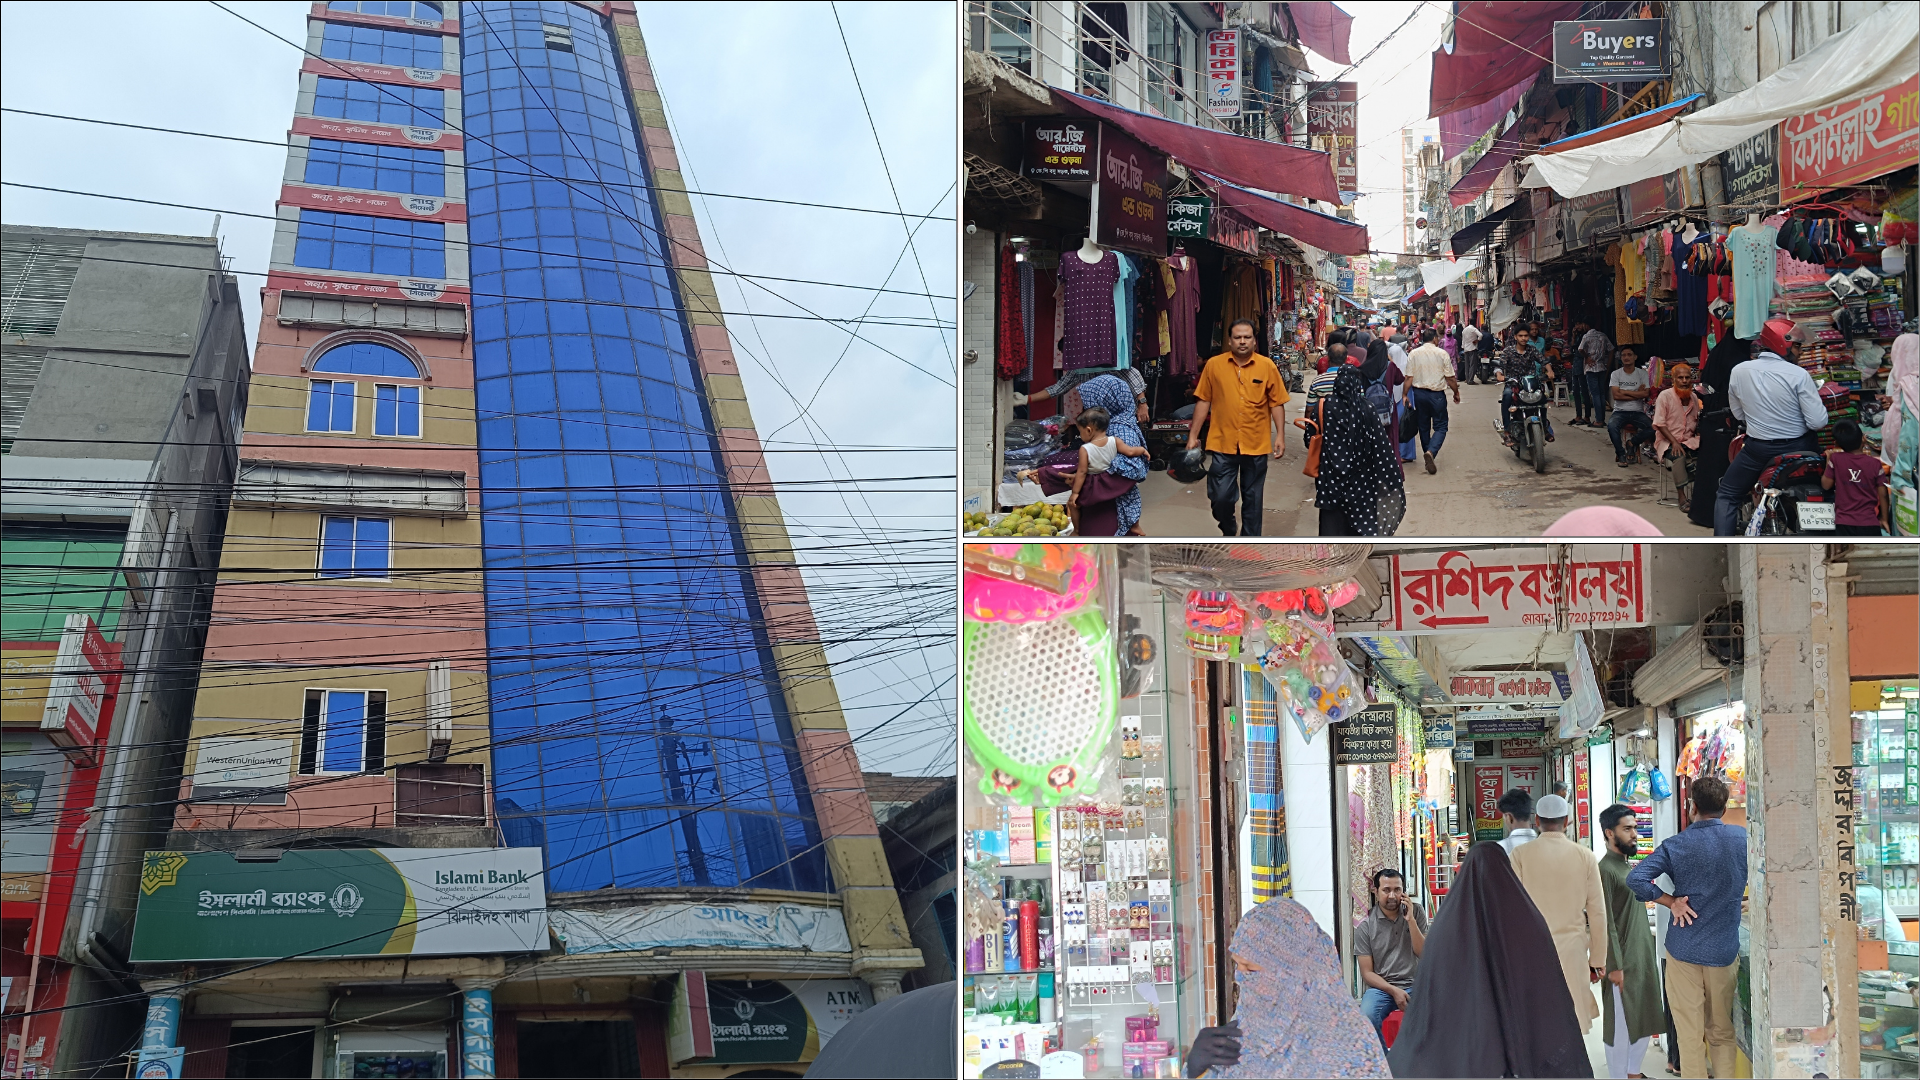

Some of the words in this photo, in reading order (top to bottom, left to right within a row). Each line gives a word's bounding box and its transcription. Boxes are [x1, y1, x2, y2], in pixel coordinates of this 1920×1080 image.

[1584, 31, 1655, 54] Buyers
[1209, 98, 1238, 107] Fashion
[1036, 125, 1084, 143] আর.জি
[1053, 142, 1086, 153] গার্মেন্টস
[1061, 156, 1082, 165] ওড়না
[1106, 149, 1143, 191] আর.জি
[1167, 200, 1203, 217] াকিজা
[1401, 551, 1515, 616] রশিদ
[1518, 560, 1634, 609] বস্ত্রালয়
[1450, 677, 1495, 699] আকবার
[1360, 710, 1394, 722] বস্ত্রালয়
[1366, 739, 1379, 750] করা
[1380, 739, 1392, 750] হয়
[435, 869, 484, 885] Islami
[488, 869, 529, 884] Bank
[198, 889, 267, 909] ইসলামী
[271, 891, 326, 907] ব্যাংক
[447, 908, 501, 925] ঝিনাইদহ
[504, 909, 530, 924] শাখা
[986, 934, 993, 949] DO
[987, 953, 993, 968] IT
[827, 991, 861, 1005] ATM
[752, 1024, 788, 1036] ব্যাংক
[998, 1062, 1024, 1070] Zirconia
